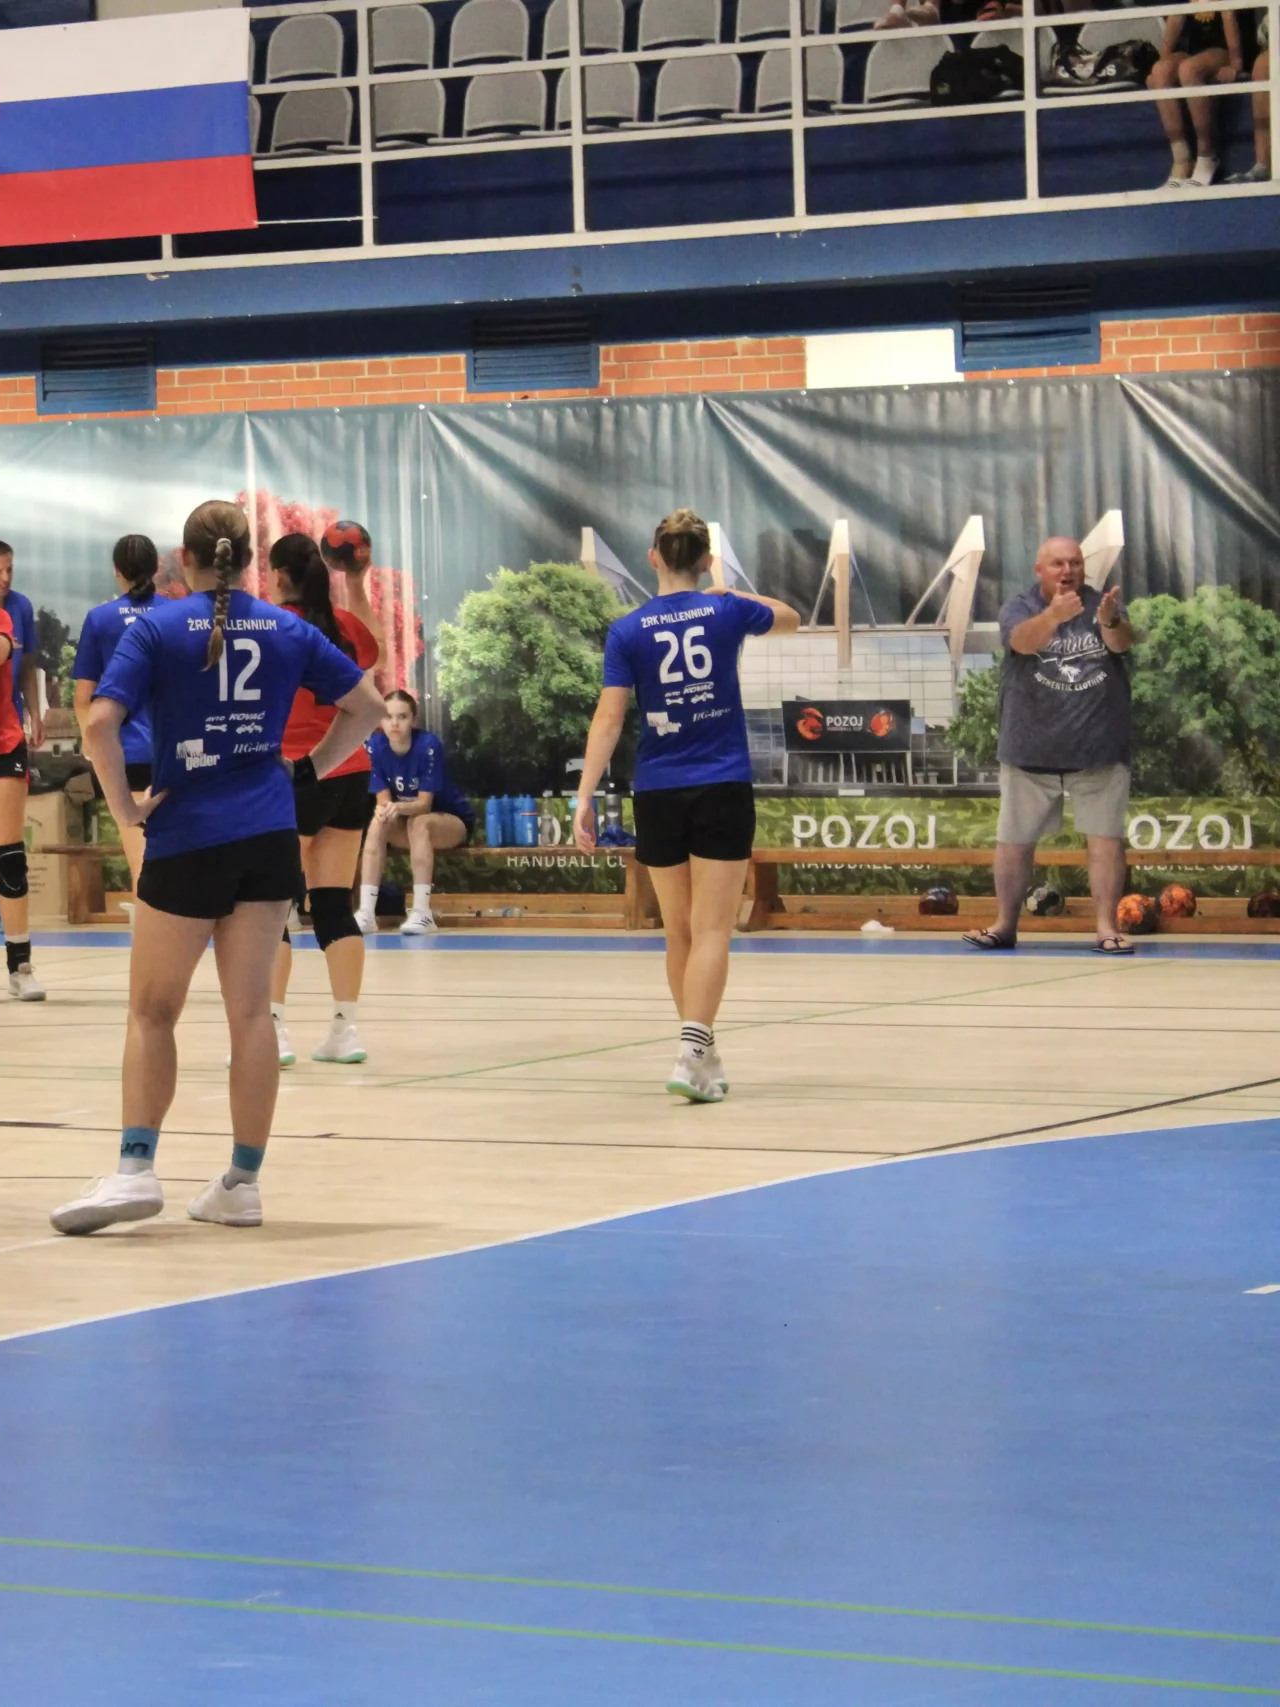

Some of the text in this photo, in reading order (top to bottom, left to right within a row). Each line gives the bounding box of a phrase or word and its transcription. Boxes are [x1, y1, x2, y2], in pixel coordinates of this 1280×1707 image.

[187, 617, 212, 631] ŽRK
[660, 606, 715, 624] MILLENNIUM
[654, 626, 713, 685] 26
[219, 638, 261, 702] 12
[1074, 670, 1108, 691] CLOTHING
[826, 716, 863, 727] POZOJ
[792, 815, 936, 849] POZOJ
